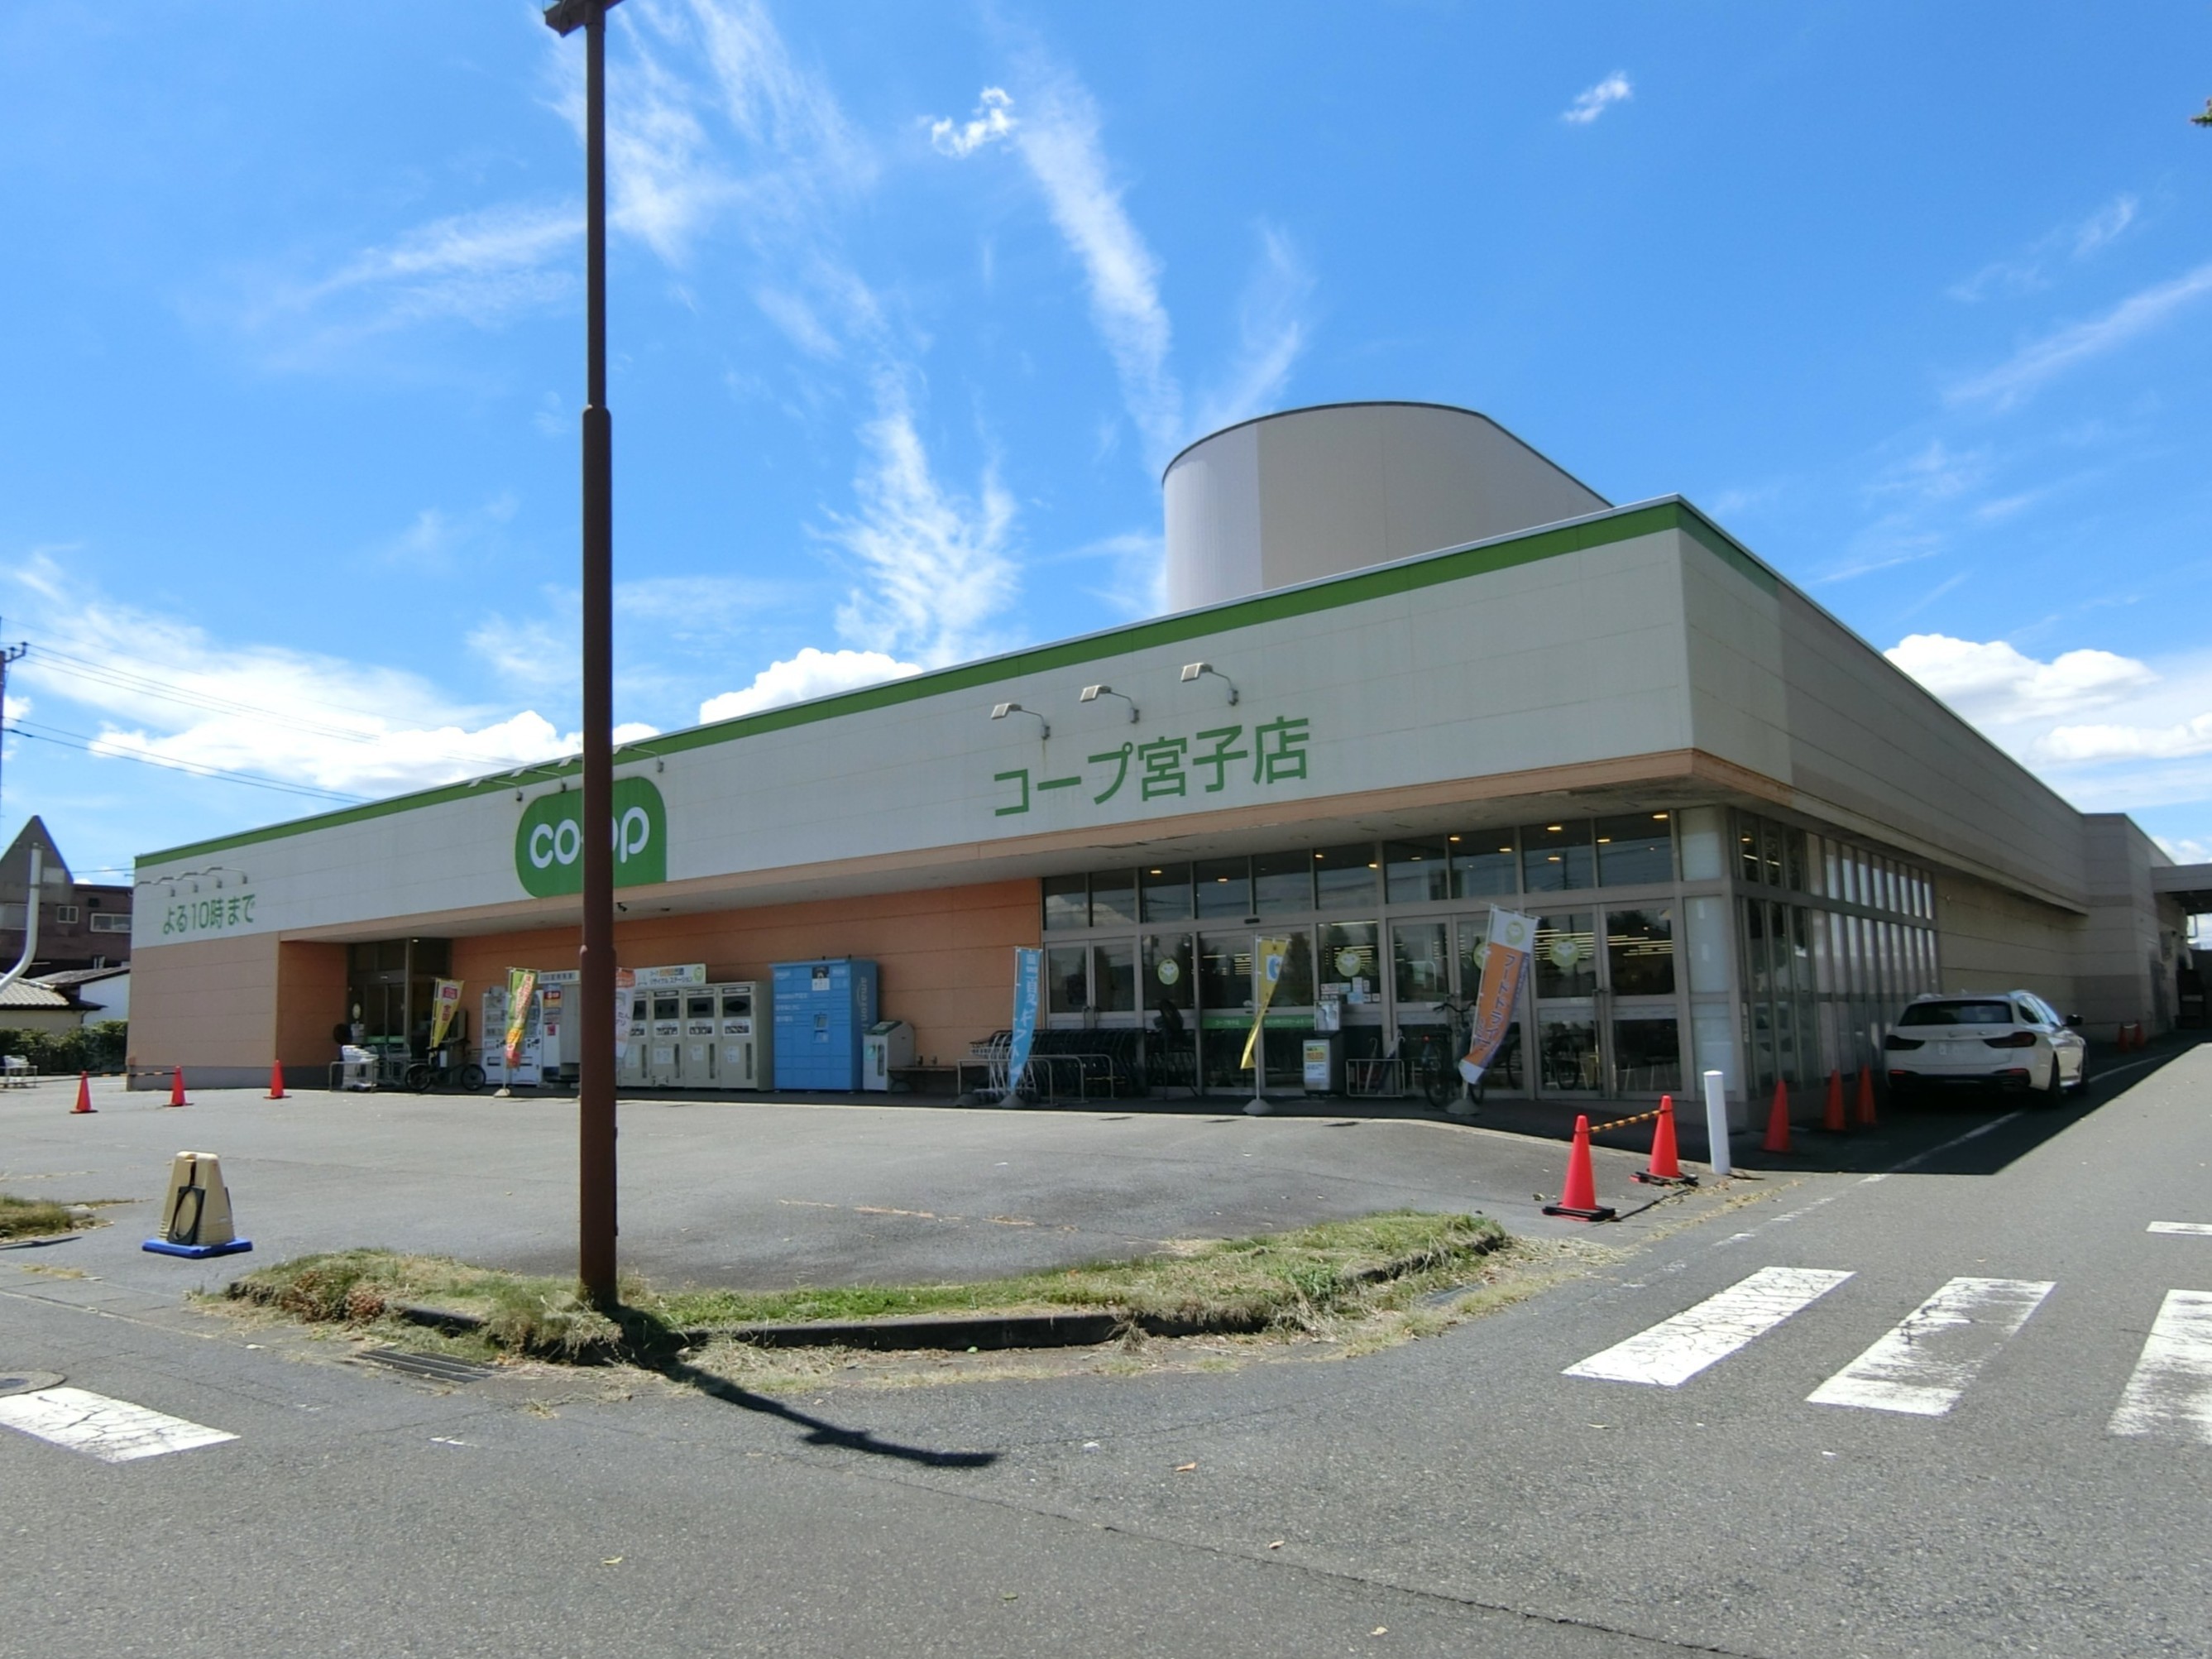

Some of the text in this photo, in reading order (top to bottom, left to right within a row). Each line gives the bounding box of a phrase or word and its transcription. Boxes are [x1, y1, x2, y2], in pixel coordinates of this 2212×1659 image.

[994, 716, 1310, 817] コープ宮子店
[529, 807, 650, 869] cop
[163, 894, 256, 935] よる10時まで
